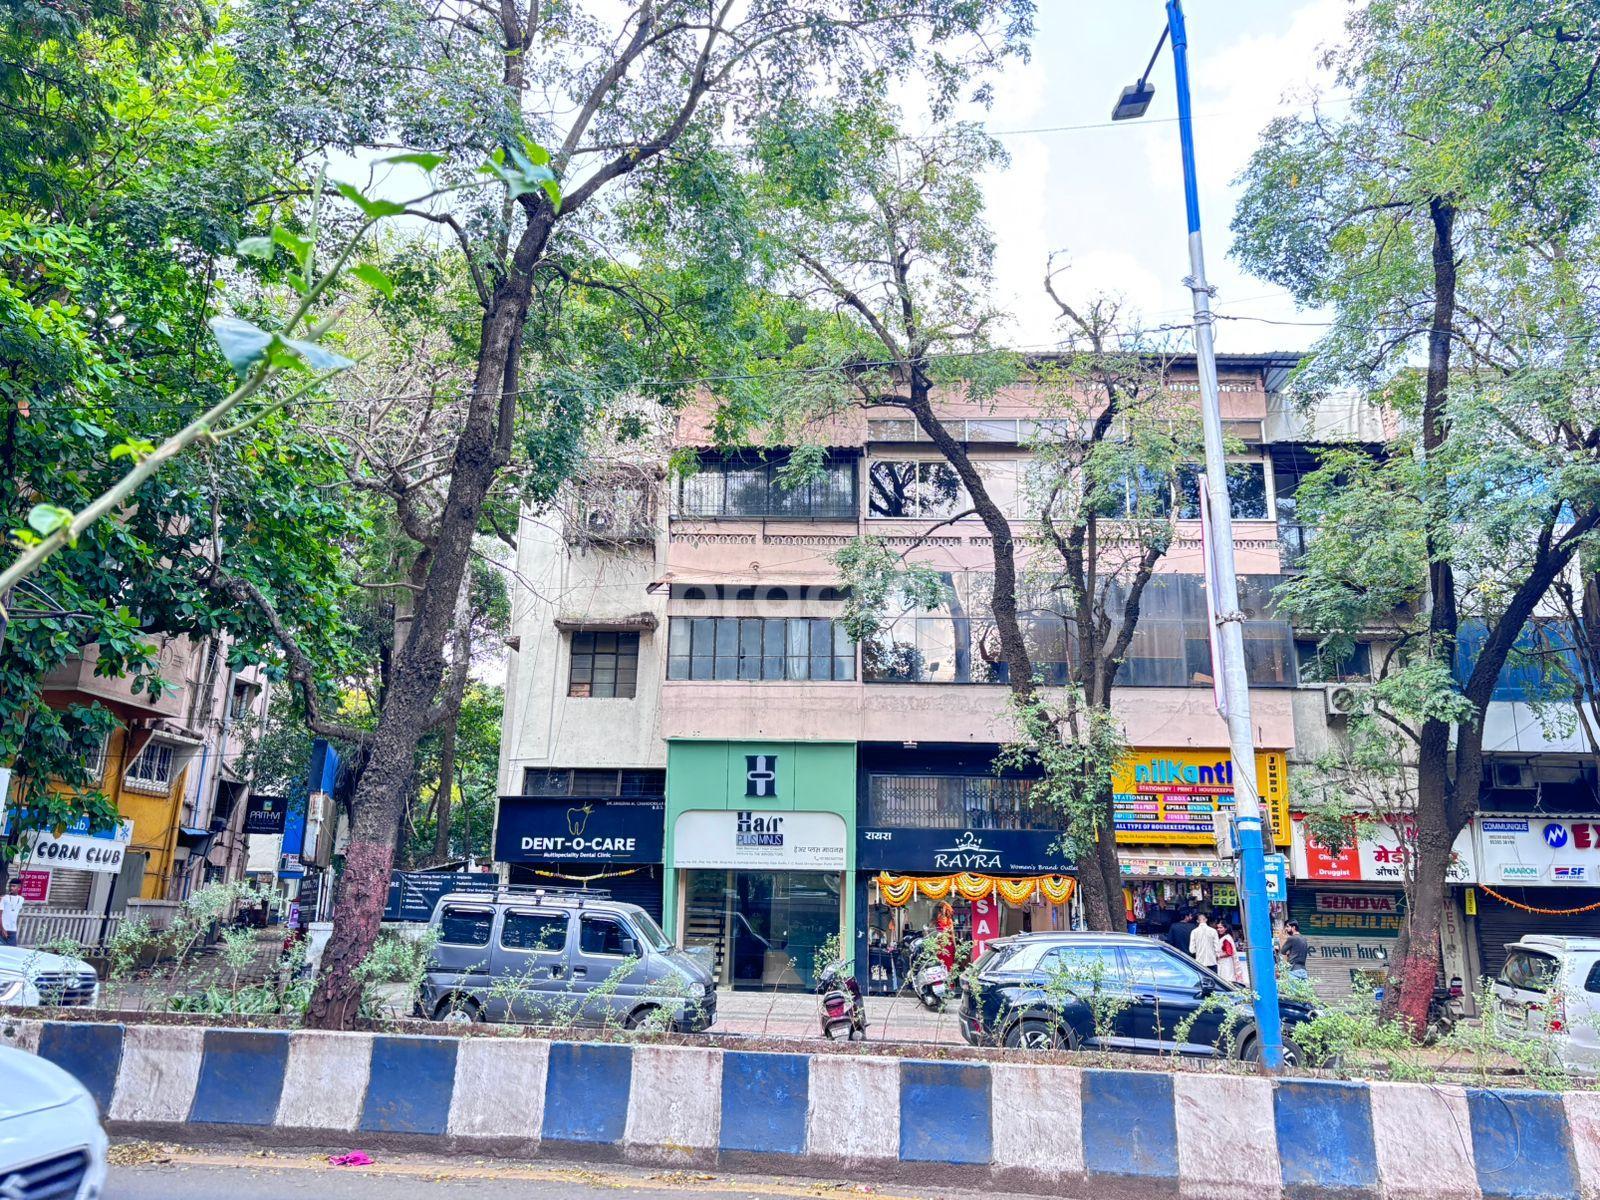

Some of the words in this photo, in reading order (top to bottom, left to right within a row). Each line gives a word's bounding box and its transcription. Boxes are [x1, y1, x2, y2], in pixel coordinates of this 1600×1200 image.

[1268, 756, 1279, 793] JUMBO
[1151, 823, 1196, 831] HOUSEKEEPING
[1483, 822, 1528, 831] COMMUNIQUE
[865, 831, 892, 840] रायरा
[521, 837, 636, 850] DENT-O-CARE
[37, 841, 81, 860] CORN
[86, 847, 120, 865] CLUB
[934, 853, 1002, 868] RAYRA
[1318, 868, 1350, 877] Druggist
[1503, 866, 1538, 875] AMARON
[1570, 867, 1585, 876] SF
[1320, 896, 1392, 911] SUNOVA
[976, 899, 991, 957] SAL
[1309, 913, 1400, 929] SPIRULIN
[1320, 943, 1352, 958] mein
